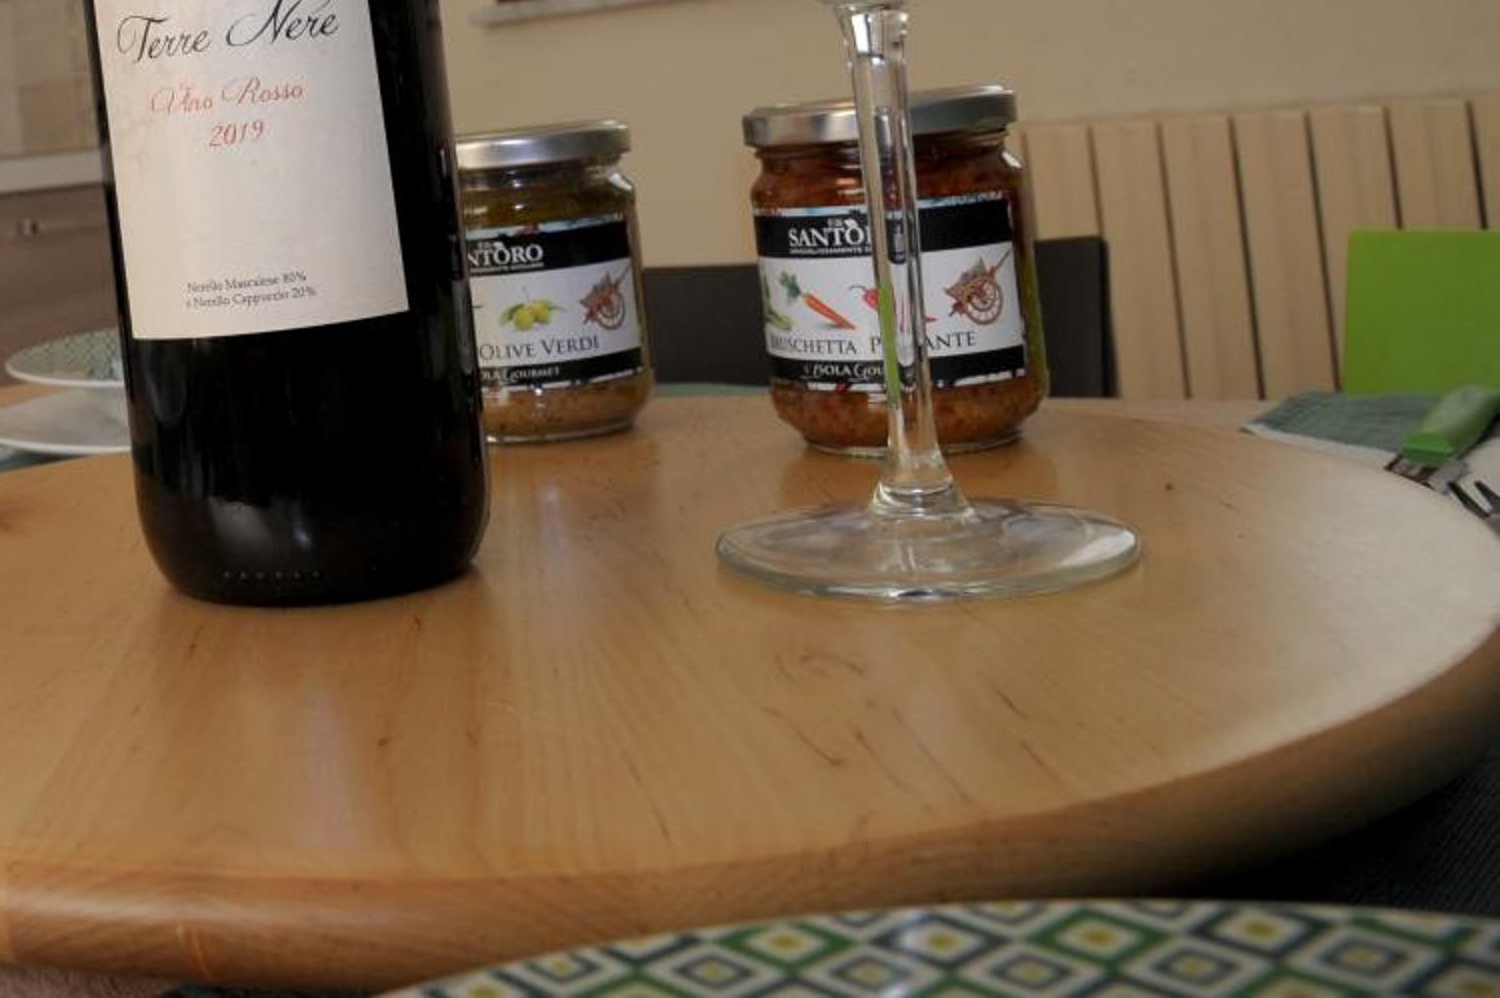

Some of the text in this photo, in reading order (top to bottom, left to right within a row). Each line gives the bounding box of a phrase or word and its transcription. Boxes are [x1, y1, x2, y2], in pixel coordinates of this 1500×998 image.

[117, 15, 212, 63] Terre
[150, 76, 304, 115] Vino Rosso
[208, 121, 266, 147] 2019
[787, 225, 872, 248] SANTO
[479, 334, 599, 361] OLIVE VERDI
